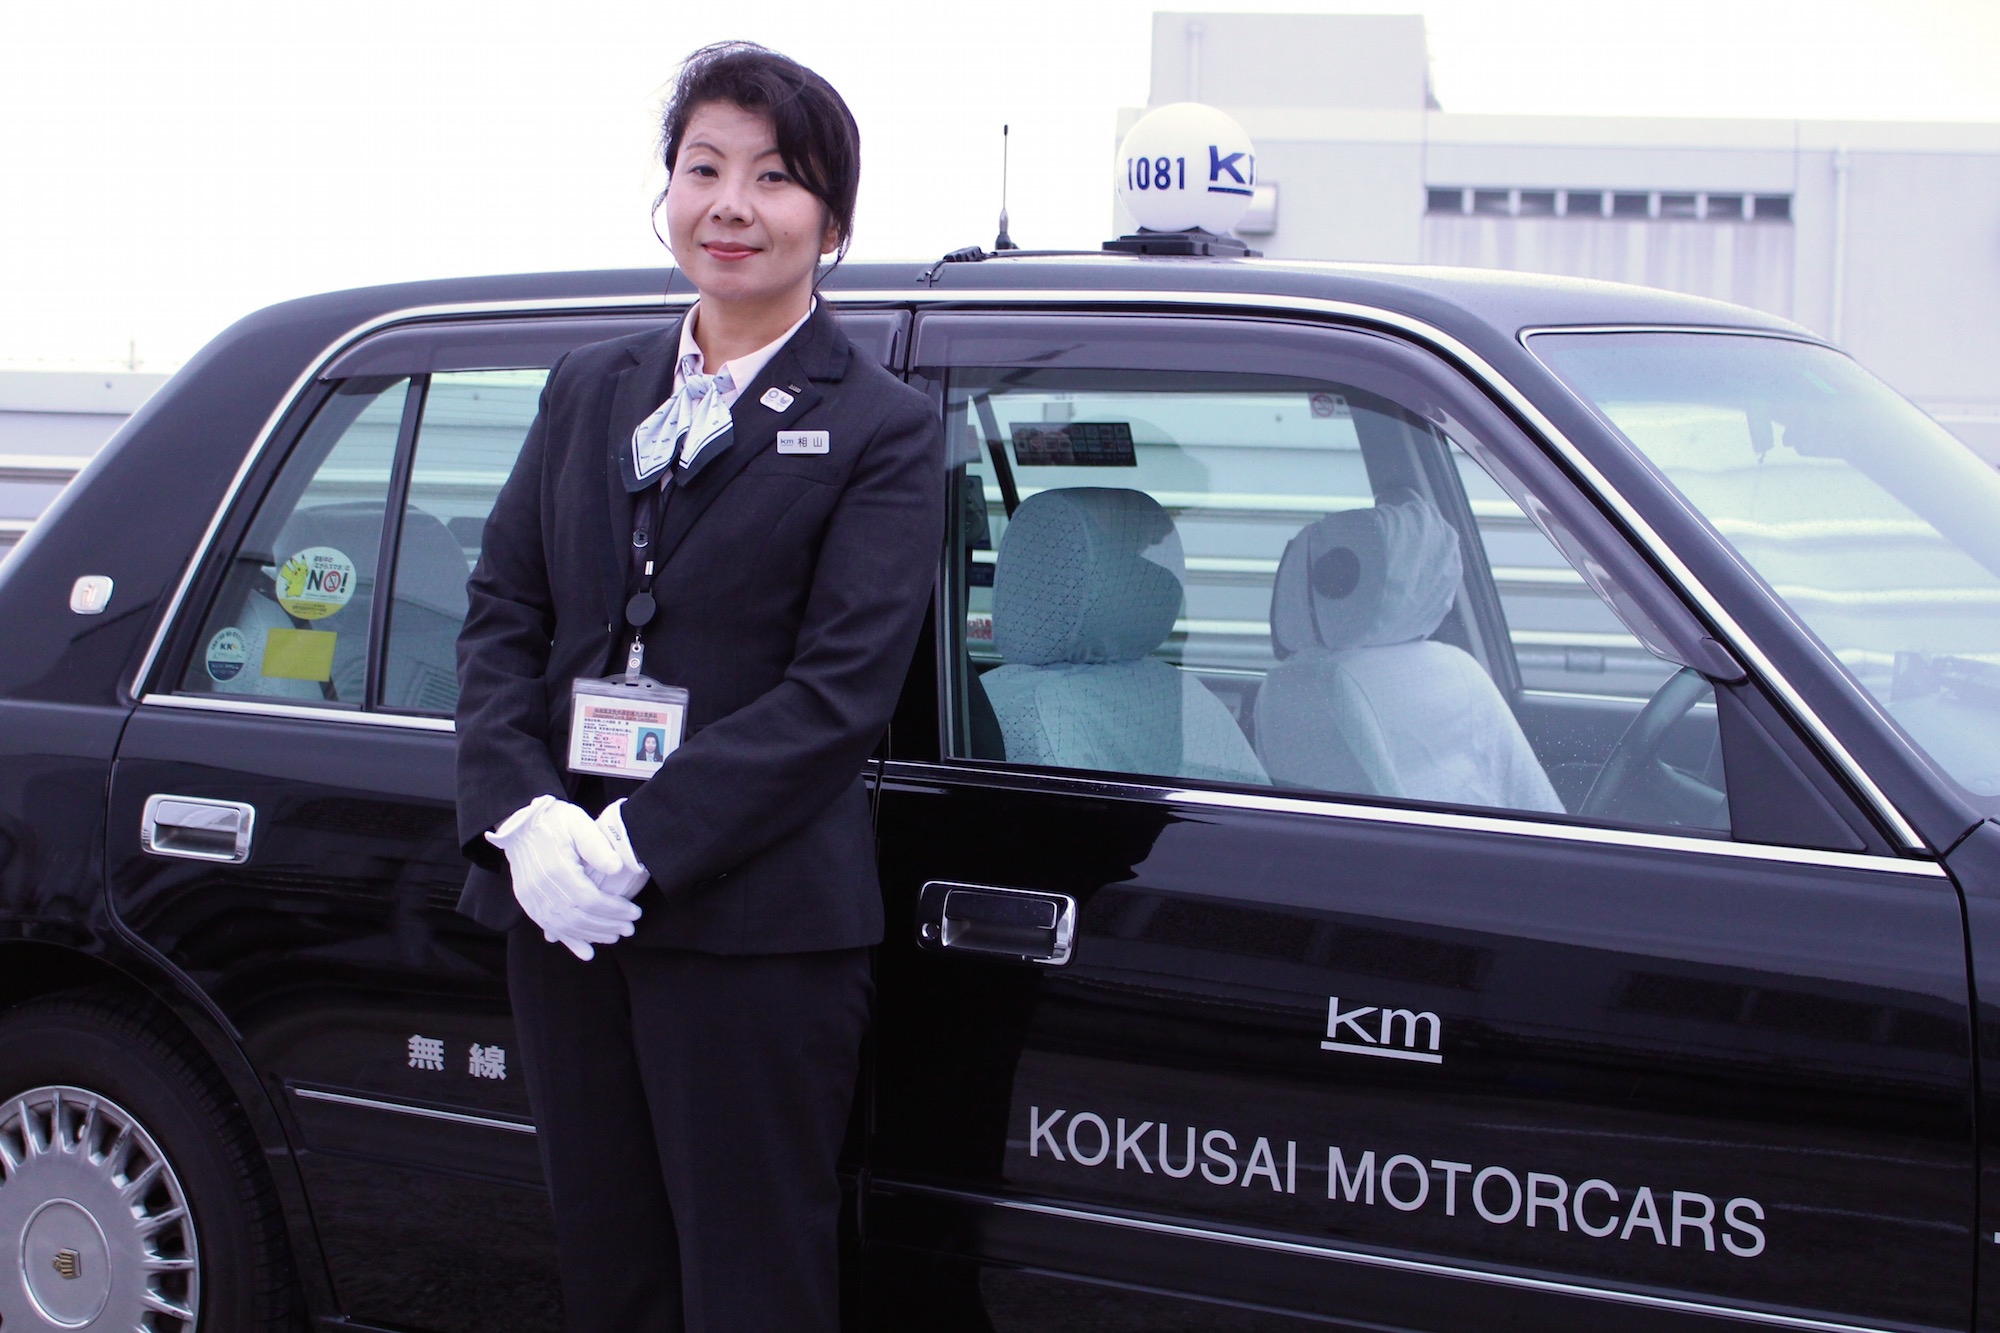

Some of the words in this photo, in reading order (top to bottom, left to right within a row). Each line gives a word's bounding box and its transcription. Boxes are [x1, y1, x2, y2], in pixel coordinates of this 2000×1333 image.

[1128, 156, 1185, 191] 1081
[1326, 996, 1442, 1051] km
[408, 1034, 507, 1081] 無線
[1029, 1105, 1297, 1195] KOKUSAI
[1327, 1146, 1766, 1257] MOTORCARS
